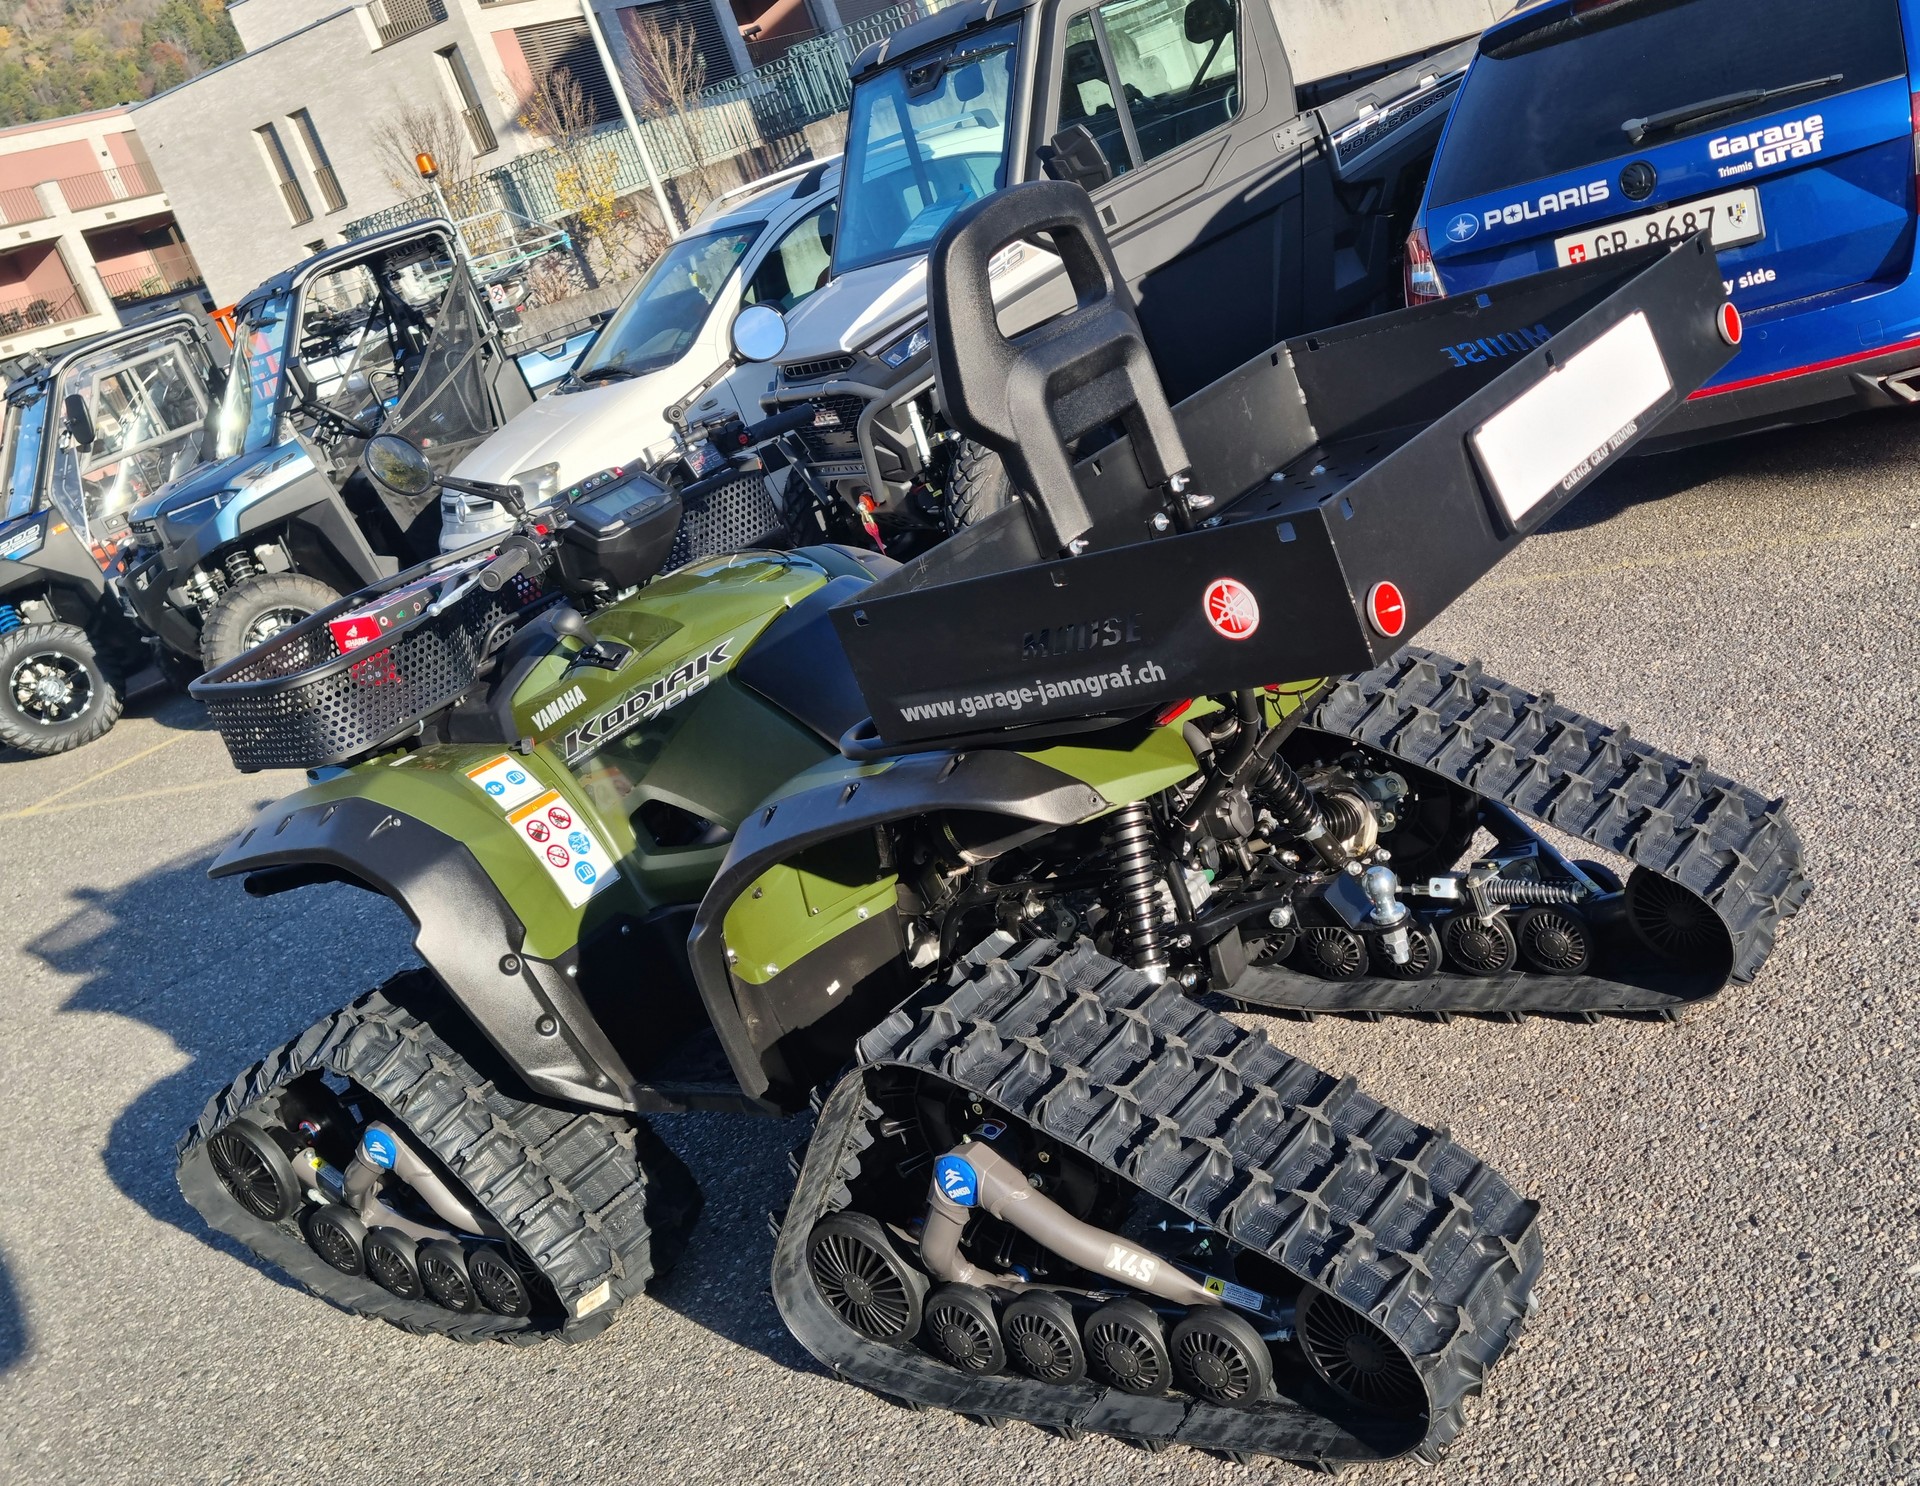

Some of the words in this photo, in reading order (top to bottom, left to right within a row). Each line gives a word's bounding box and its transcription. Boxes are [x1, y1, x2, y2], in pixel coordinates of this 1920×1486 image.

[1709, 114, 1824, 160] Garage
[1754, 130, 1824, 168] Graf
[1718, 161, 1753, 178] Trimmis
[1484, 180, 1609, 230] POLARIS
[1739, 268, 1776, 288] side
[1562, 459, 1592, 490] GARAGE
[1590, 443, 1610, 466] GRAF
[1609, 420, 1637, 451] TRIMMIS
[531, 685, 587, 732] YAMAHA
[565, 637, 735, 759] KODIAK
[900, 661, 1167, 722] www.garage-janngraf.ch
[568, 746, 595, 766] POWER
[597, 718, 639, 746] STEERING
[643, 675, 710, 722] 700
[948, 1186, 970, 1198] CAMSO
[1107, 1246, 1155, 1282] X4S
